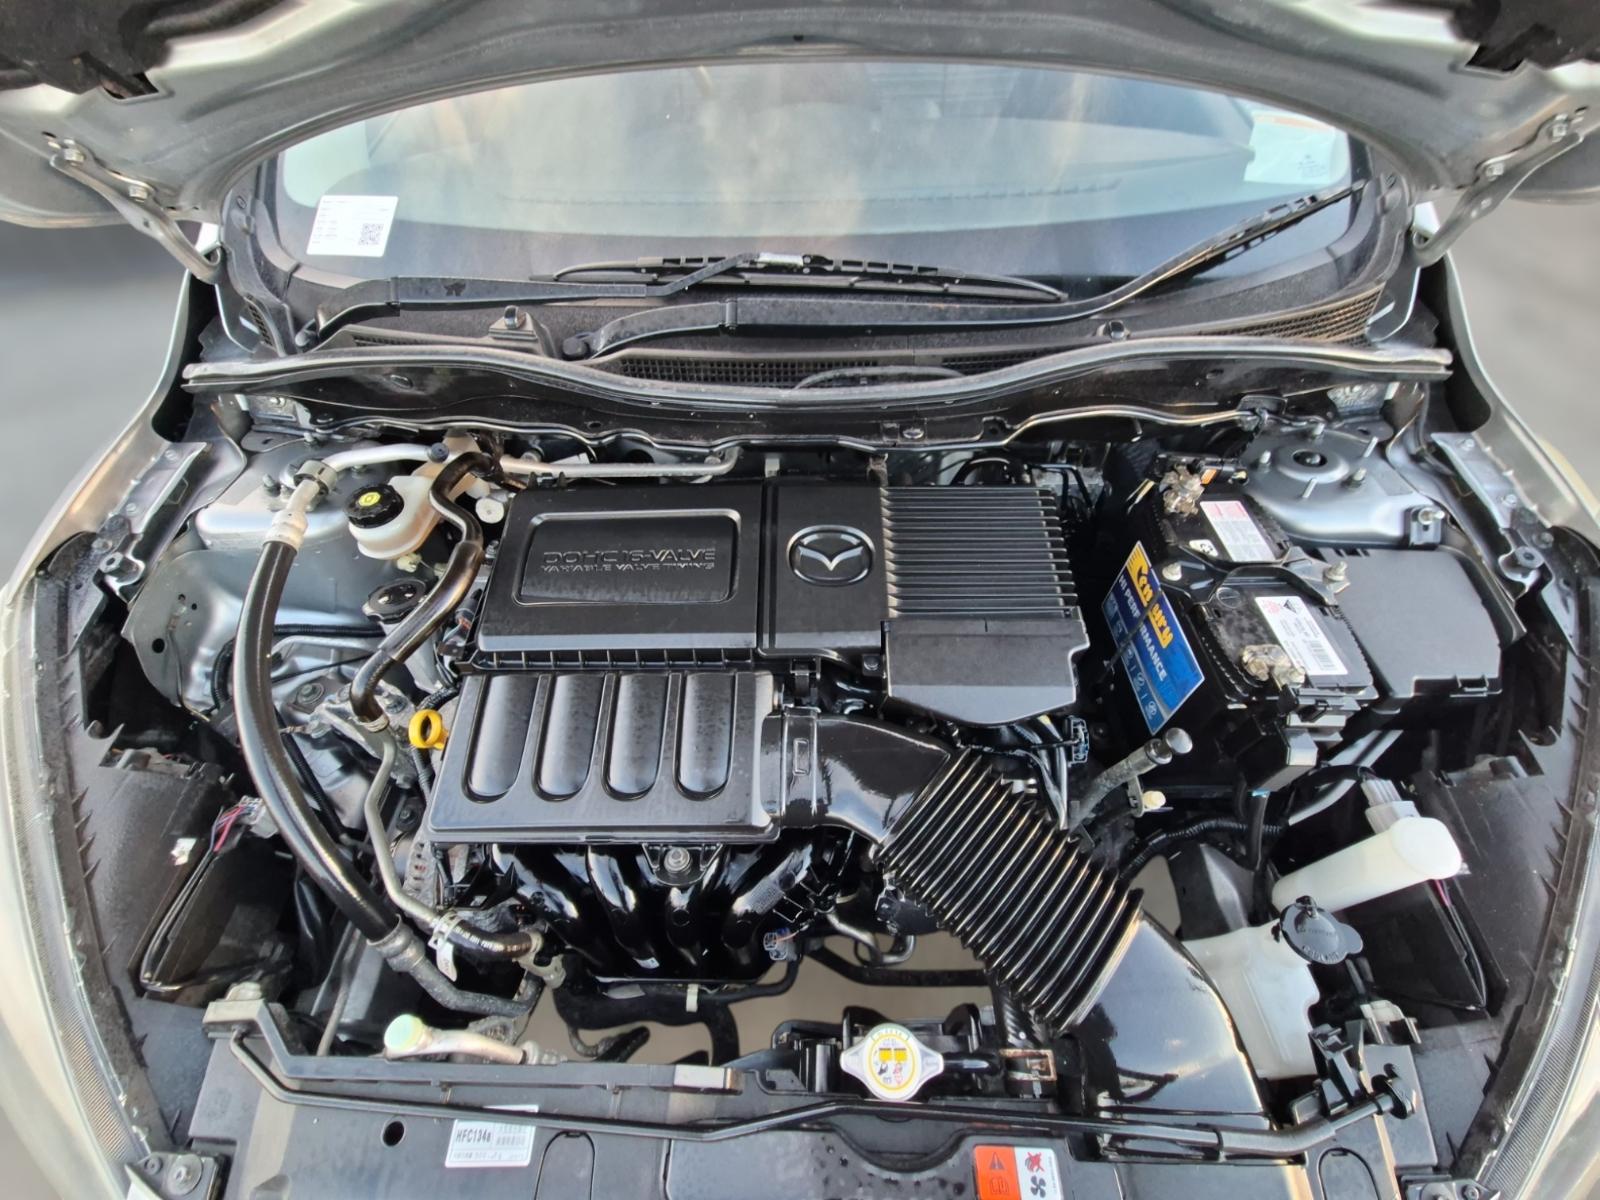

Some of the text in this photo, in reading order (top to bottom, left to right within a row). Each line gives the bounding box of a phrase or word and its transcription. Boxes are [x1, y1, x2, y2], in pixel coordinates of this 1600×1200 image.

[543, 547, 716, 564] DOHC 16-VALVE
[1118, 573, 1129, 591] HI
[1134, 559, 1175, 649] Cenury
[1123, 586, 1169, 683] PERFRMANCE
